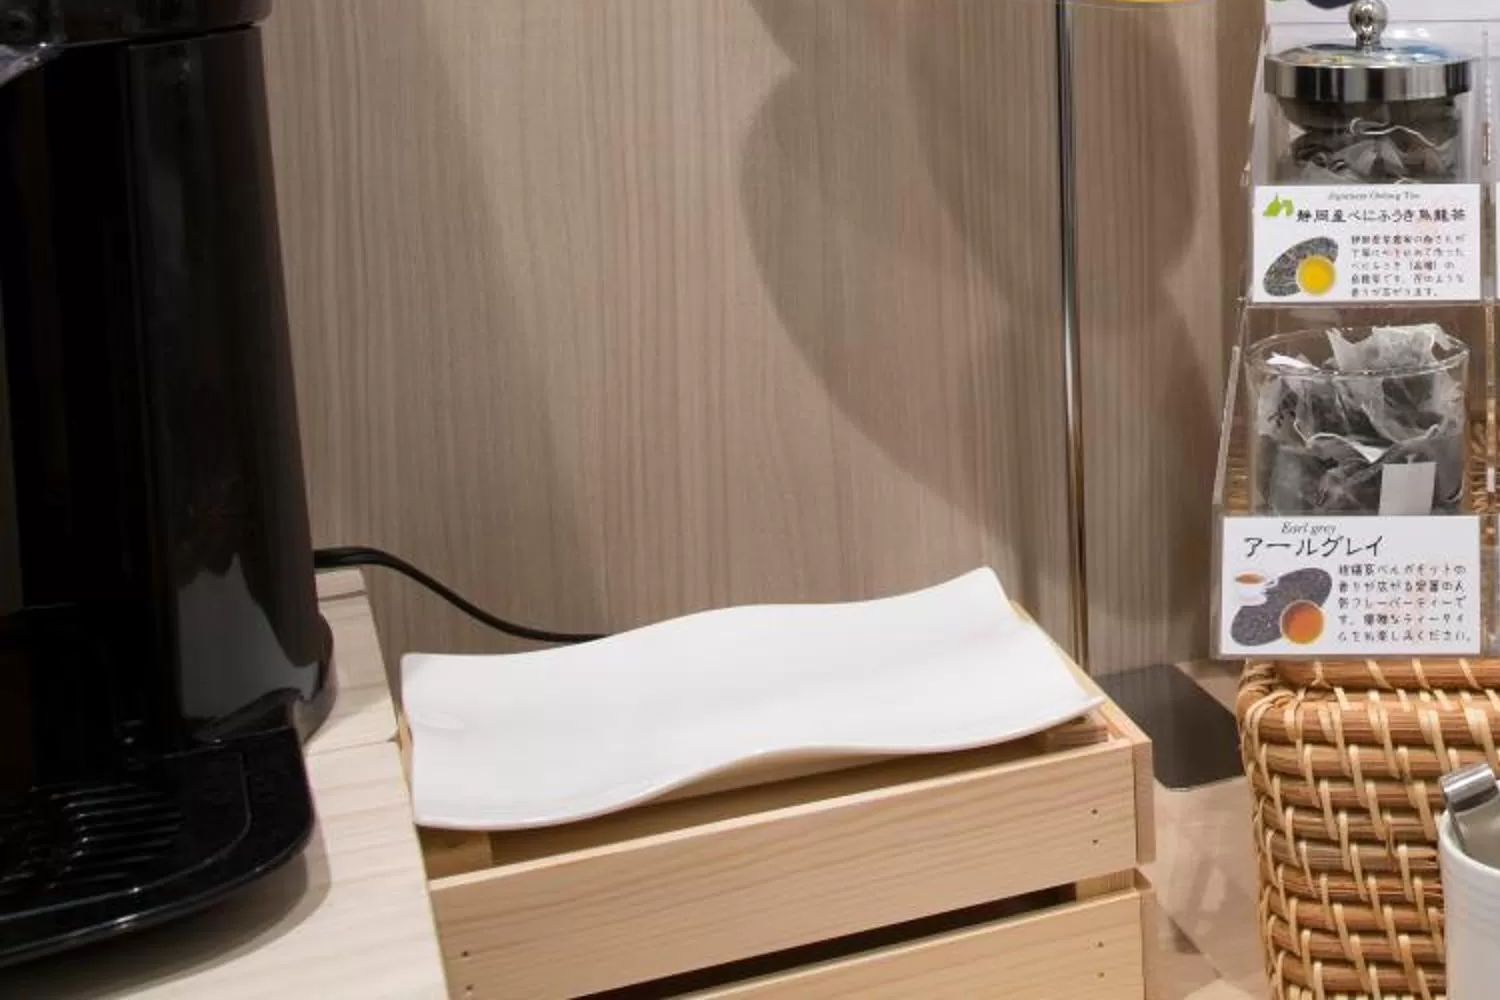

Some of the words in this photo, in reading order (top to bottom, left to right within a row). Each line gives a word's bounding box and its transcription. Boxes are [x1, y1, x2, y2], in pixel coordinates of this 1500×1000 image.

[1243, 535, 1384, 558] アールグレイ
